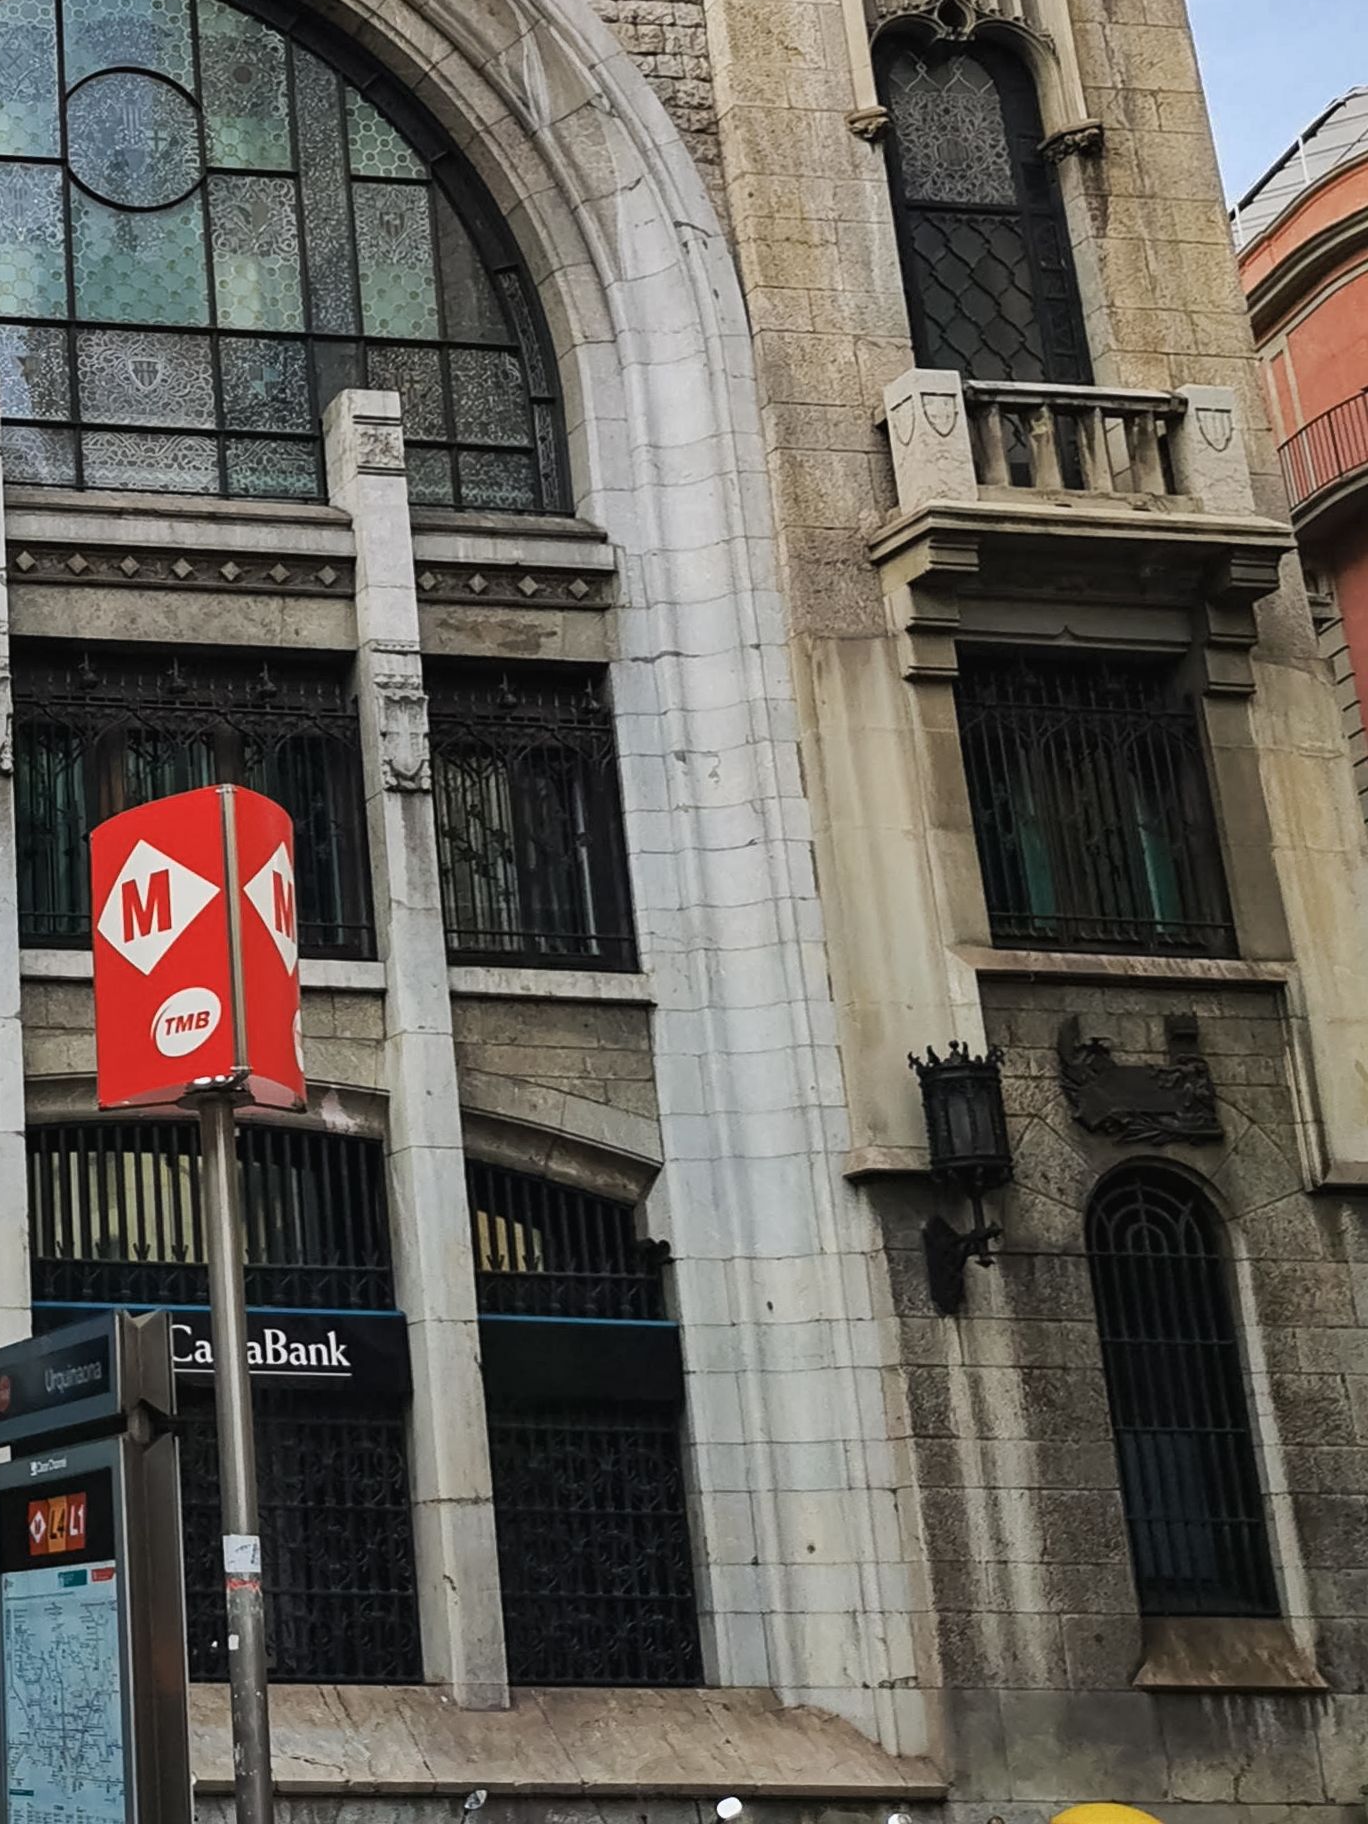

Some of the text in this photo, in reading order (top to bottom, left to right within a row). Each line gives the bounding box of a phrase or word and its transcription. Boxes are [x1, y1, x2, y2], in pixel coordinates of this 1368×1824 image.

[121, 869, 173, 944] M
[164, 1009, 212, 1037] TMB
[170, 1324, 353, 1367] CaaBank
[49, 1506, 66, 1540] L4
[69, 1503, 85, 1537] L1
